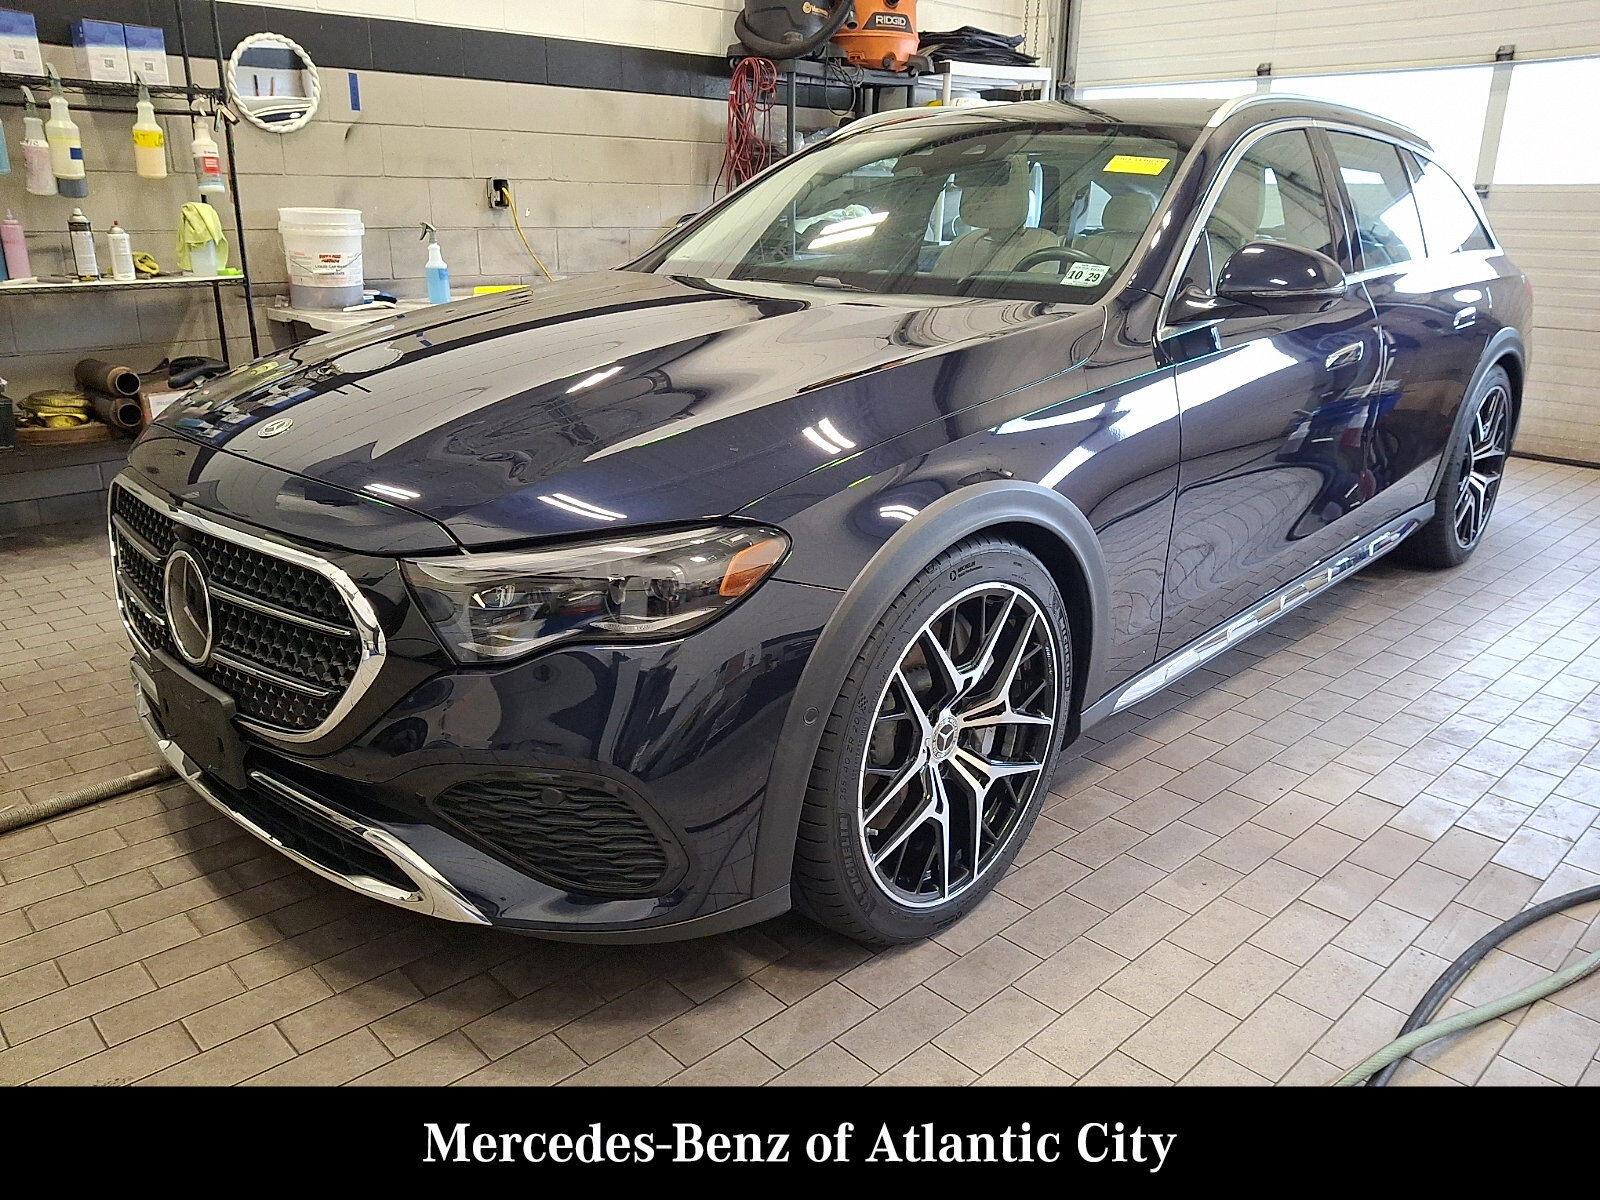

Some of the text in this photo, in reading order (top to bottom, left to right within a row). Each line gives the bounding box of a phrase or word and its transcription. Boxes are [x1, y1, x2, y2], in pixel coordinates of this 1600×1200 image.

[875, 15, 907, 26] RIDGID
[1067, 270, 1100, 282] 10 29
[838, 815, 864, 895] MICHELIN
